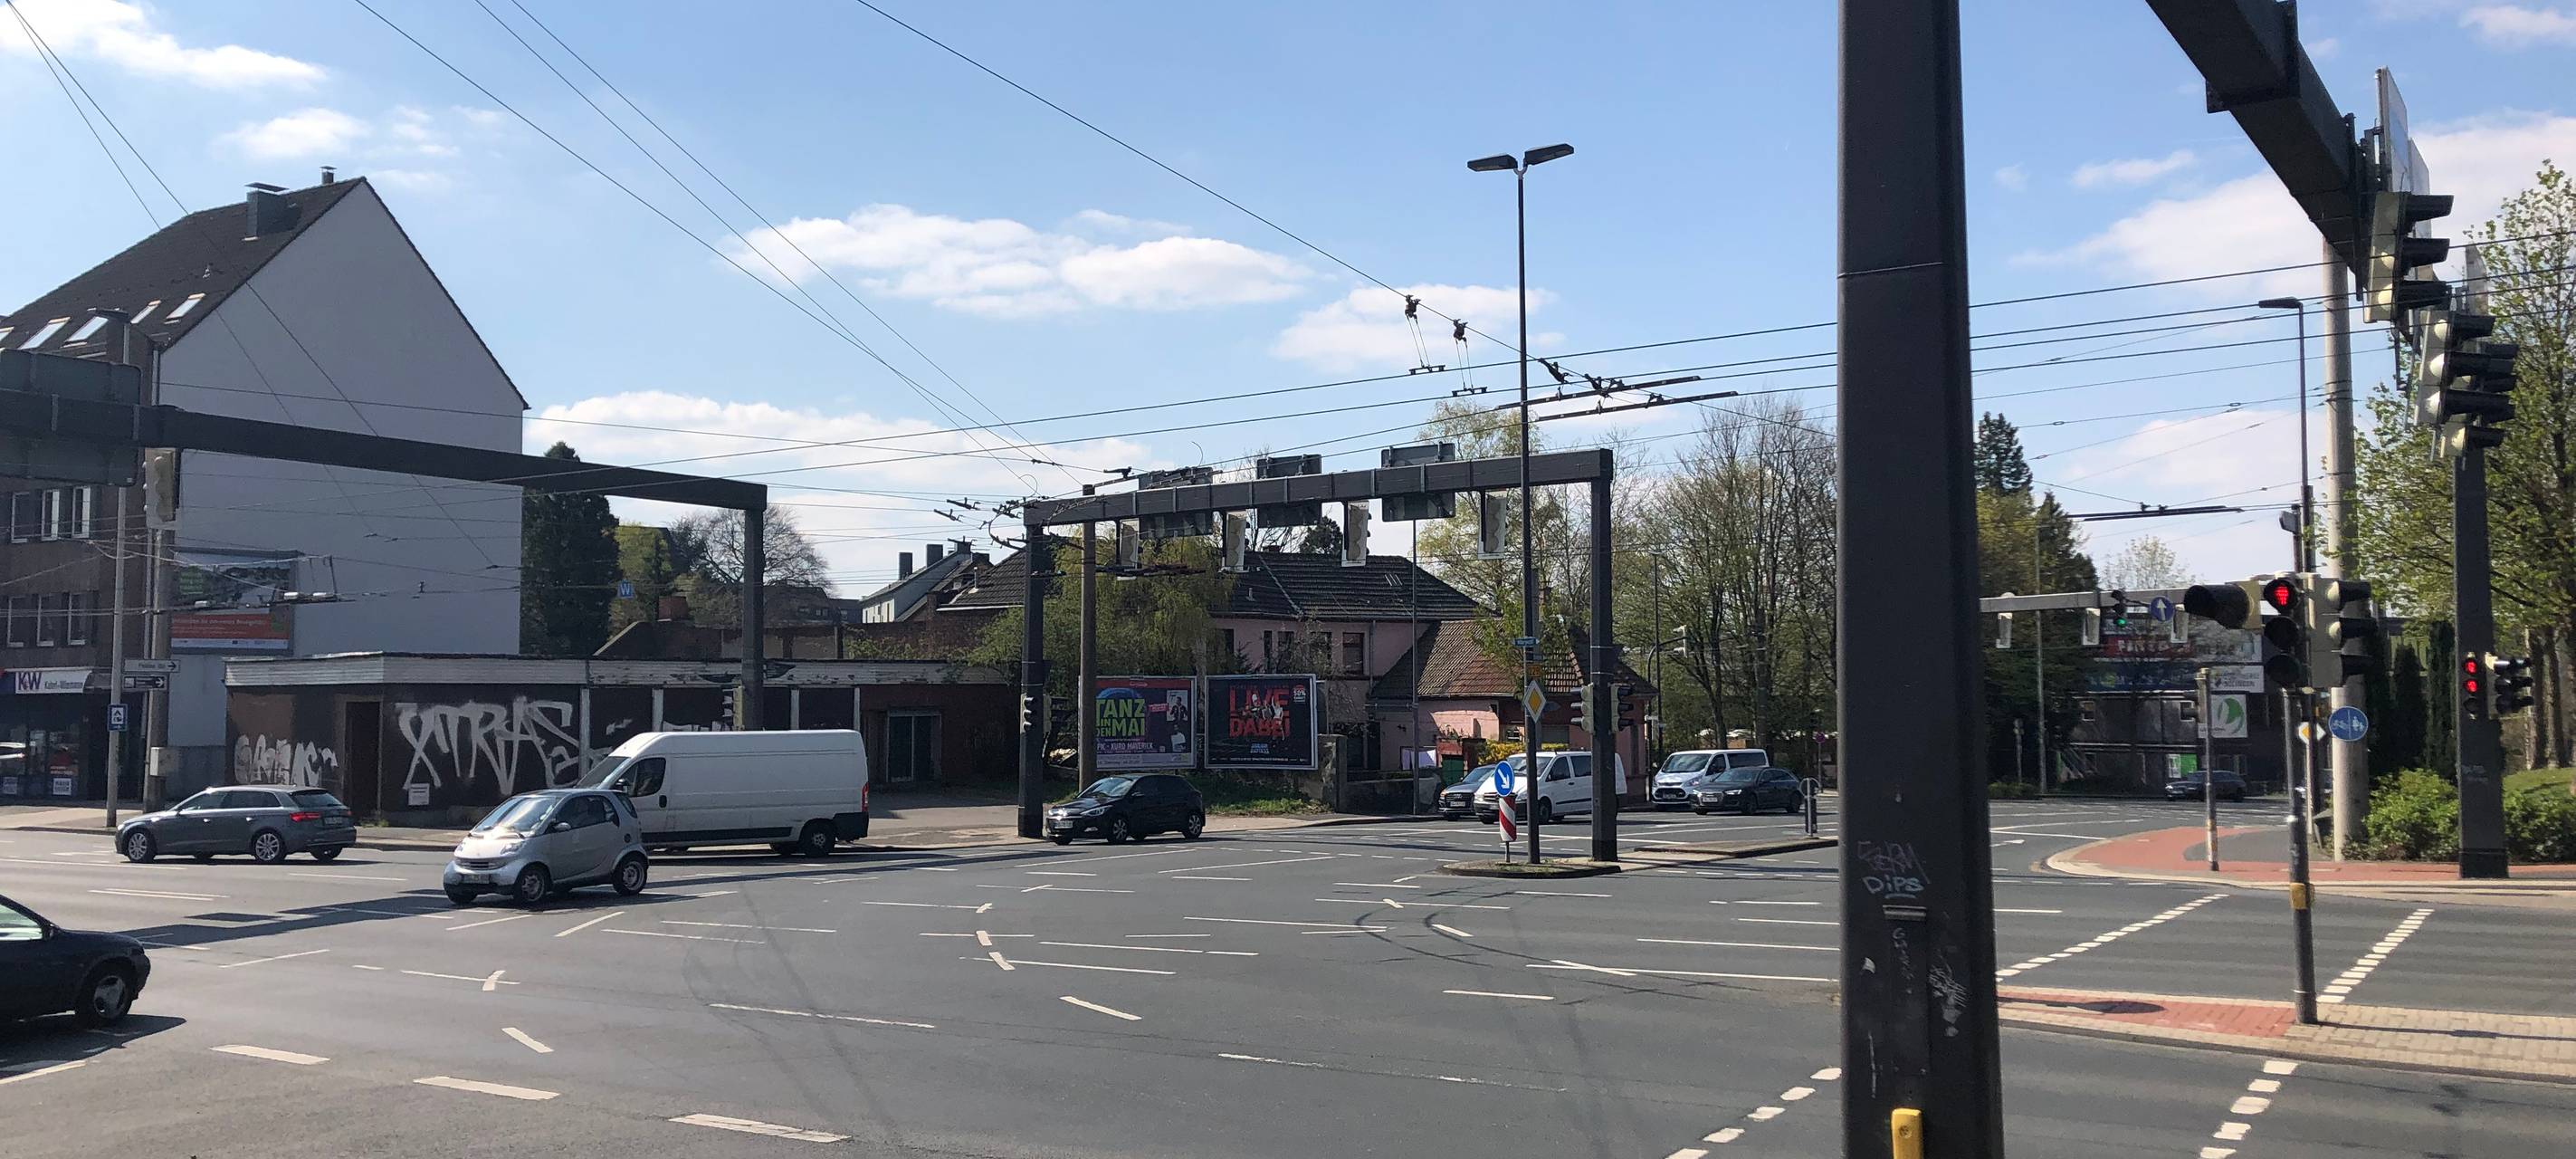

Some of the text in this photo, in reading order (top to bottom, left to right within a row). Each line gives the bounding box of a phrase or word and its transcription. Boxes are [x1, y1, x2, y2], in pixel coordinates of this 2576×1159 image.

[1096, 698, 1145, 727] TANZ
[1111, 718, 1145, 737] MAI
[1229, 717, 1290, 739] DABEI
